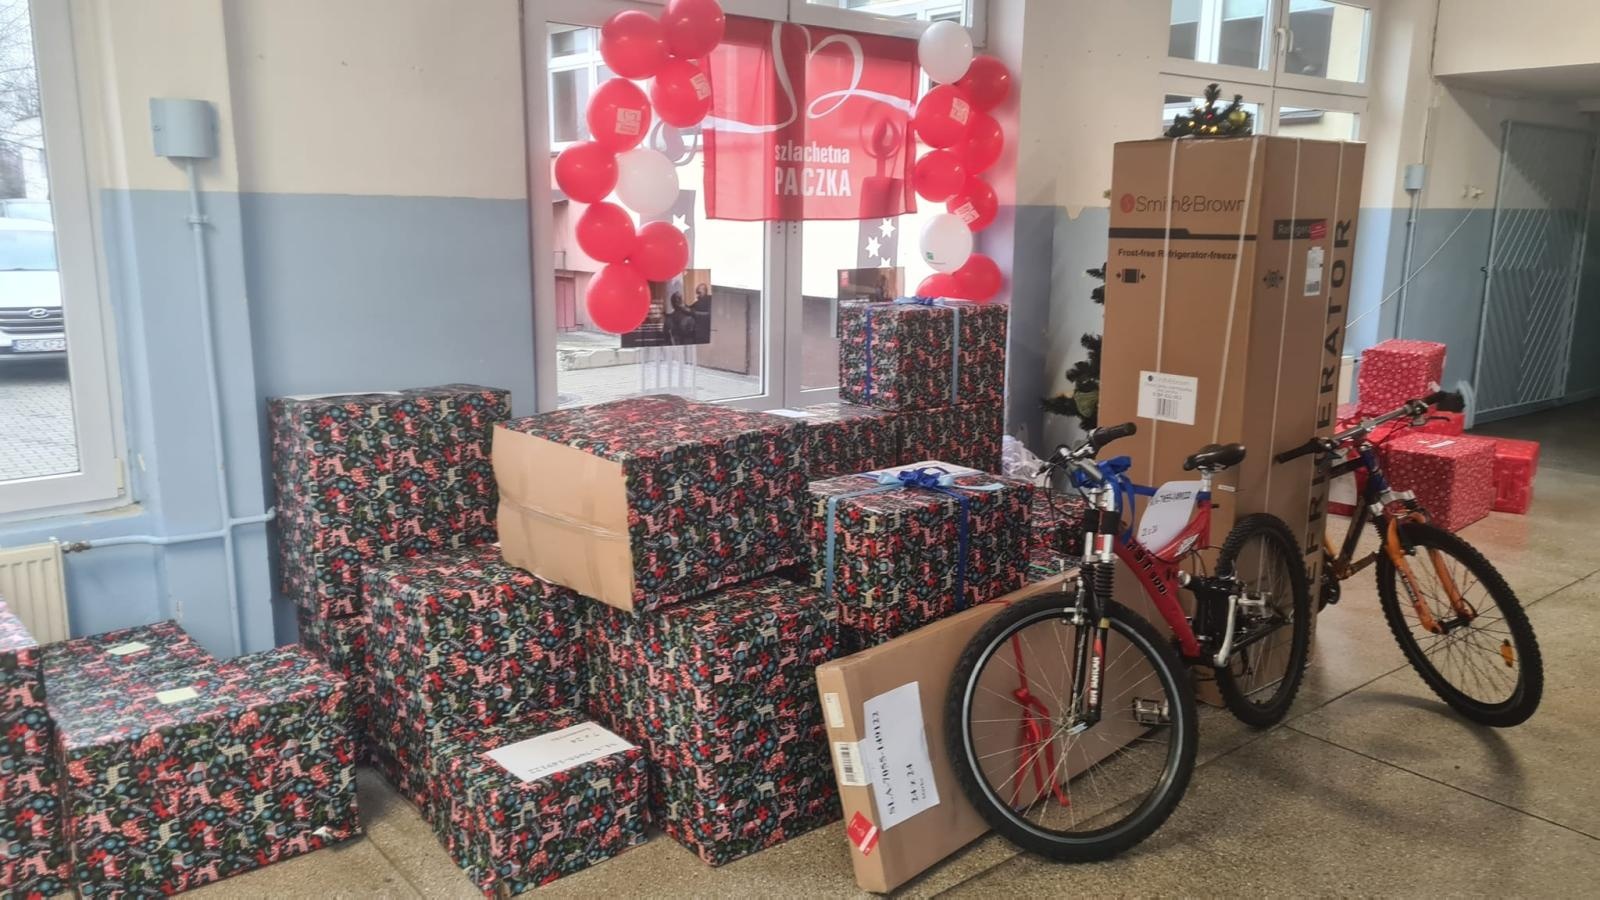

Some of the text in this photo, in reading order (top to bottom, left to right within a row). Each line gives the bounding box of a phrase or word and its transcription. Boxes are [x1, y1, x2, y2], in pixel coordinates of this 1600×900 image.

[774, 139, 850, 164] szlachetna
[774, 166, 852, 197] PACZKA
[1136, 194, 1246, 213] Smih&Brown
[1118, 248, 1156, 258] Frost-free
